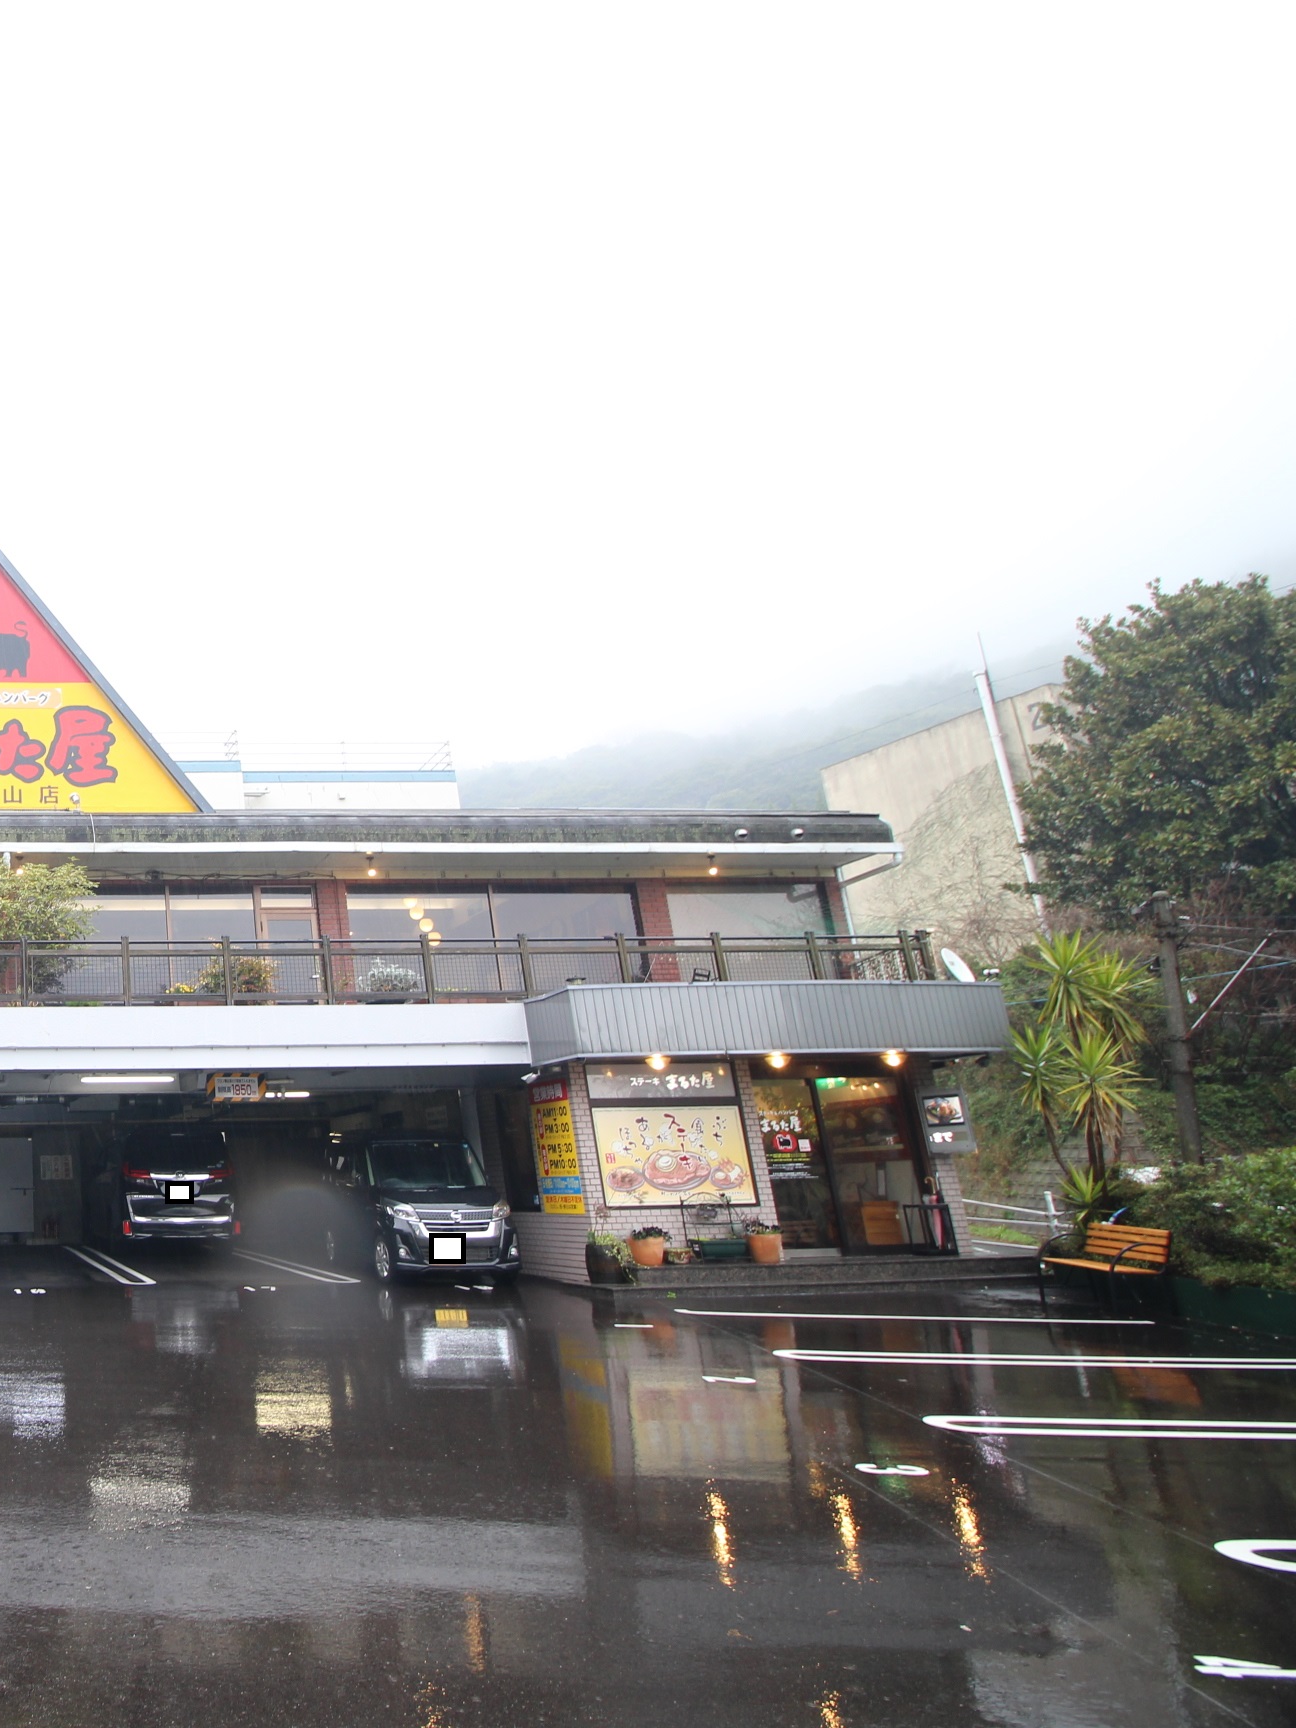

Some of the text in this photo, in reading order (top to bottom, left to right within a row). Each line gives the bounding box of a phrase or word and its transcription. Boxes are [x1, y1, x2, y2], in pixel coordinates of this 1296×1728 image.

[630, 1071, 715, 1090] ステーキ まるた屋
[231, 1084, 252, 1096] 1950
[760, 1116, 802, 1133] まるた屋
[663, 1113, 693, 1170] ステーキ
[854, 1463, 930, 1476] 3
